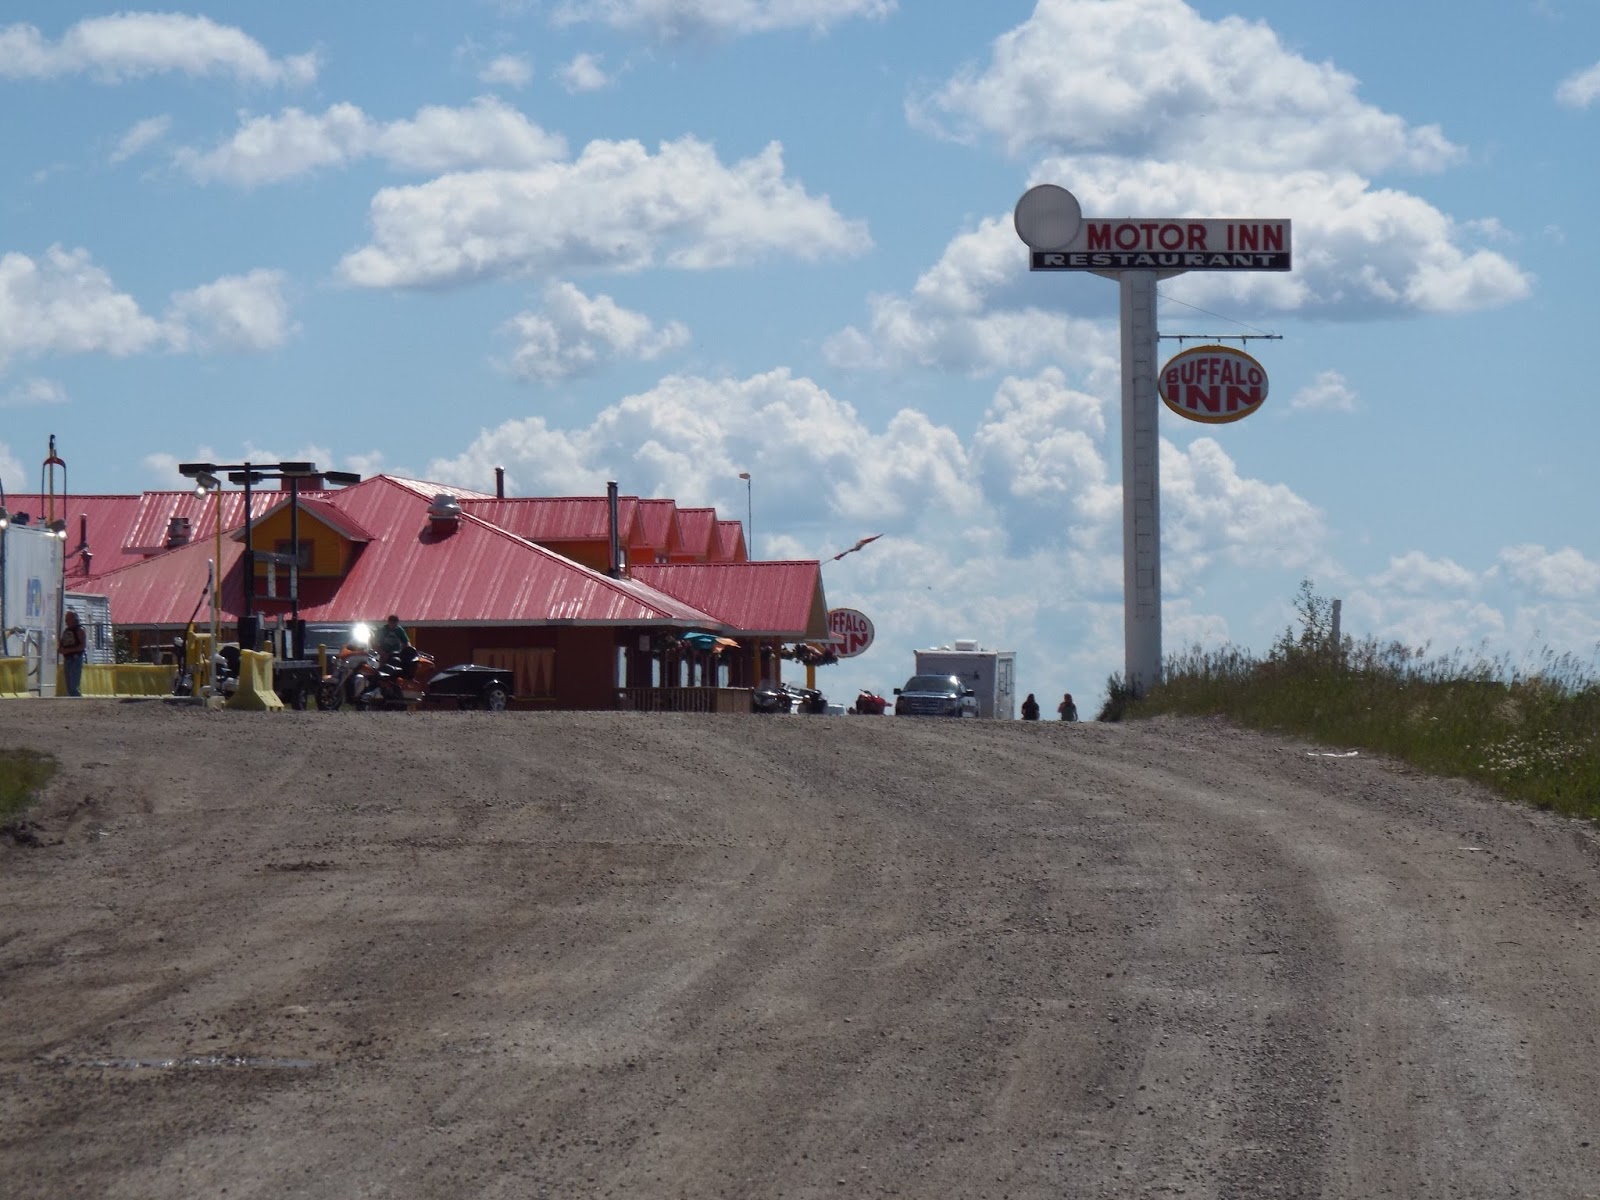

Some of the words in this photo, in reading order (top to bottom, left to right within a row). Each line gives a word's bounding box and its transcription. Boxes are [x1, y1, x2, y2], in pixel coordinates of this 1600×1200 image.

[1087, 223, 1208, 251] MOTOR
[1227, 224, 1283, 251] INN
[1043, 253, 1276, 267] RESTAURANT
[1165, 357, 1263, 386] BUFFALO
[1167, 384, 1261, 412] INN
[829, 632, 868, 654] NN
